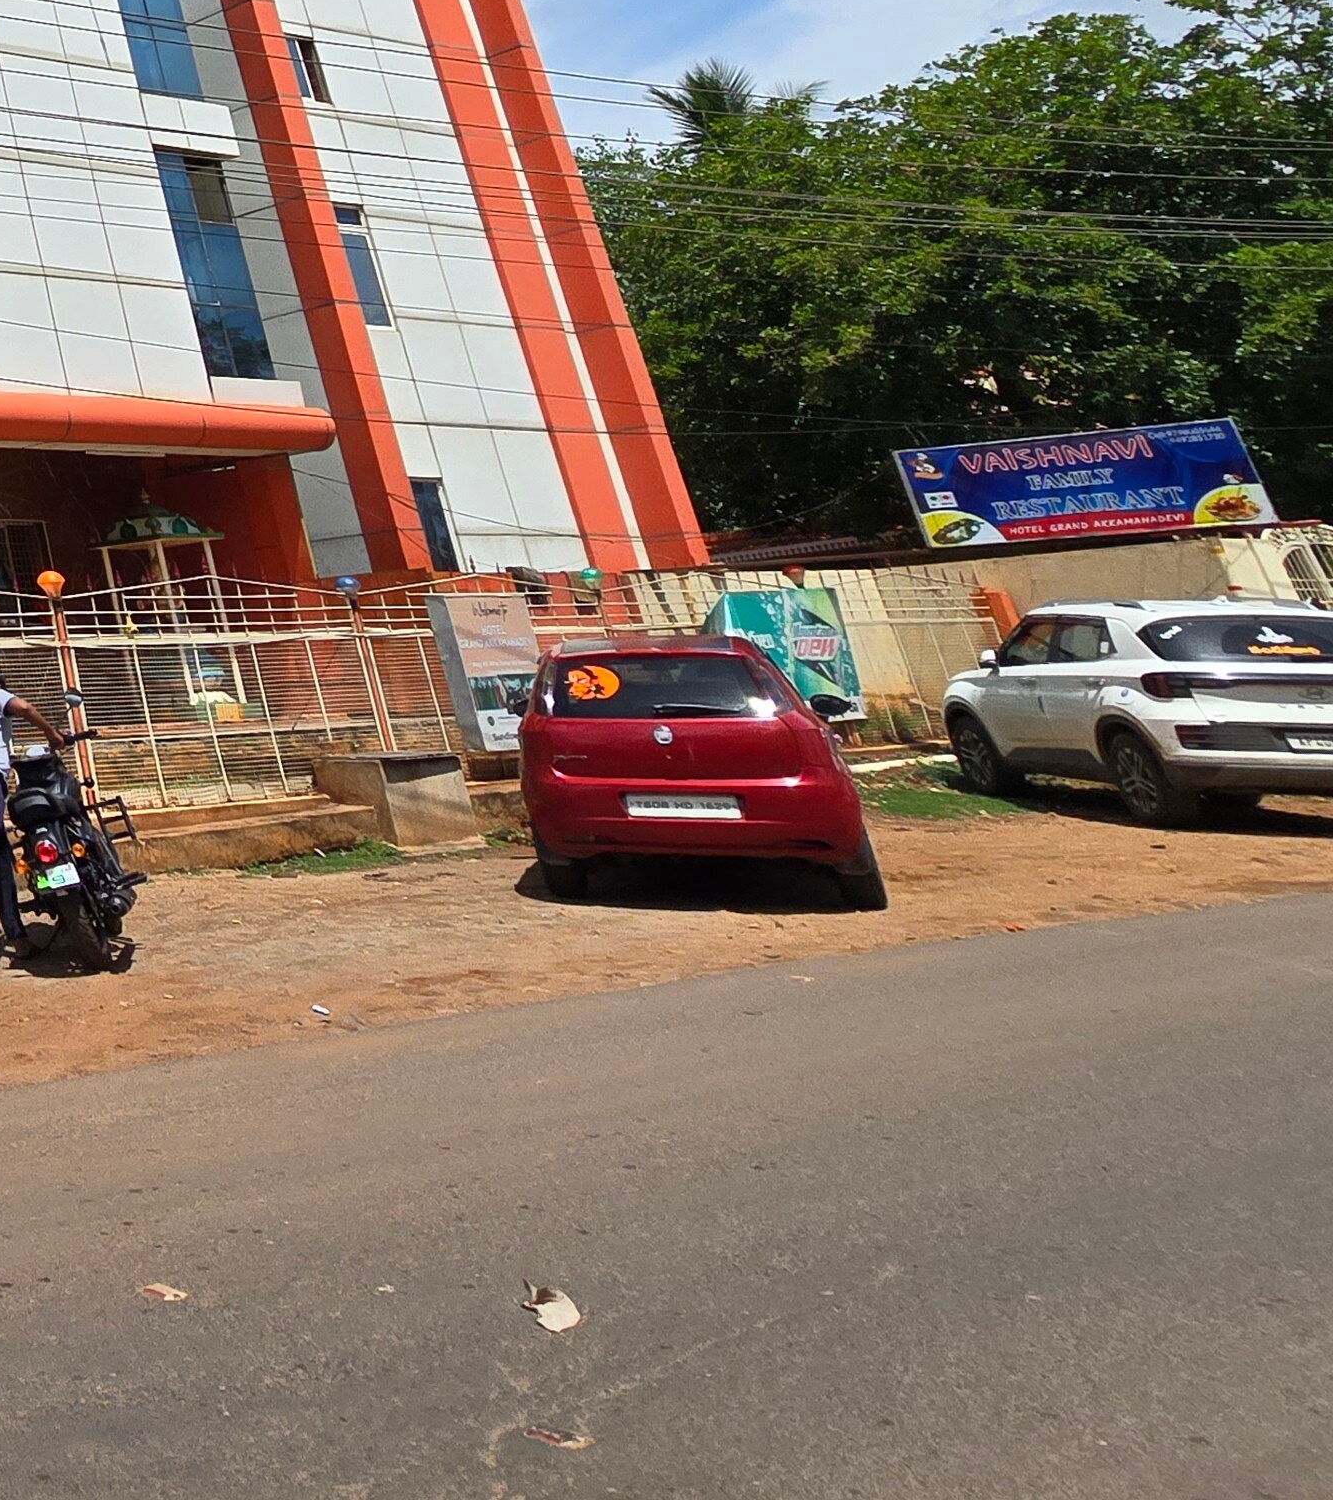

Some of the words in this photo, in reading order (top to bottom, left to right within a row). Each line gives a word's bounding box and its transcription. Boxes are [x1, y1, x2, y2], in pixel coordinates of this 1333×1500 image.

[1025, 468, 1114, 491] FAMILY
[990, 486, 1185, 520] RESTAURANT
[1009, 524, 1045, 535] HOTEL
[1049, 521, 1090, 533] GRAND
[1093, 513, 1186, 529] AKKAMAHADEVI
